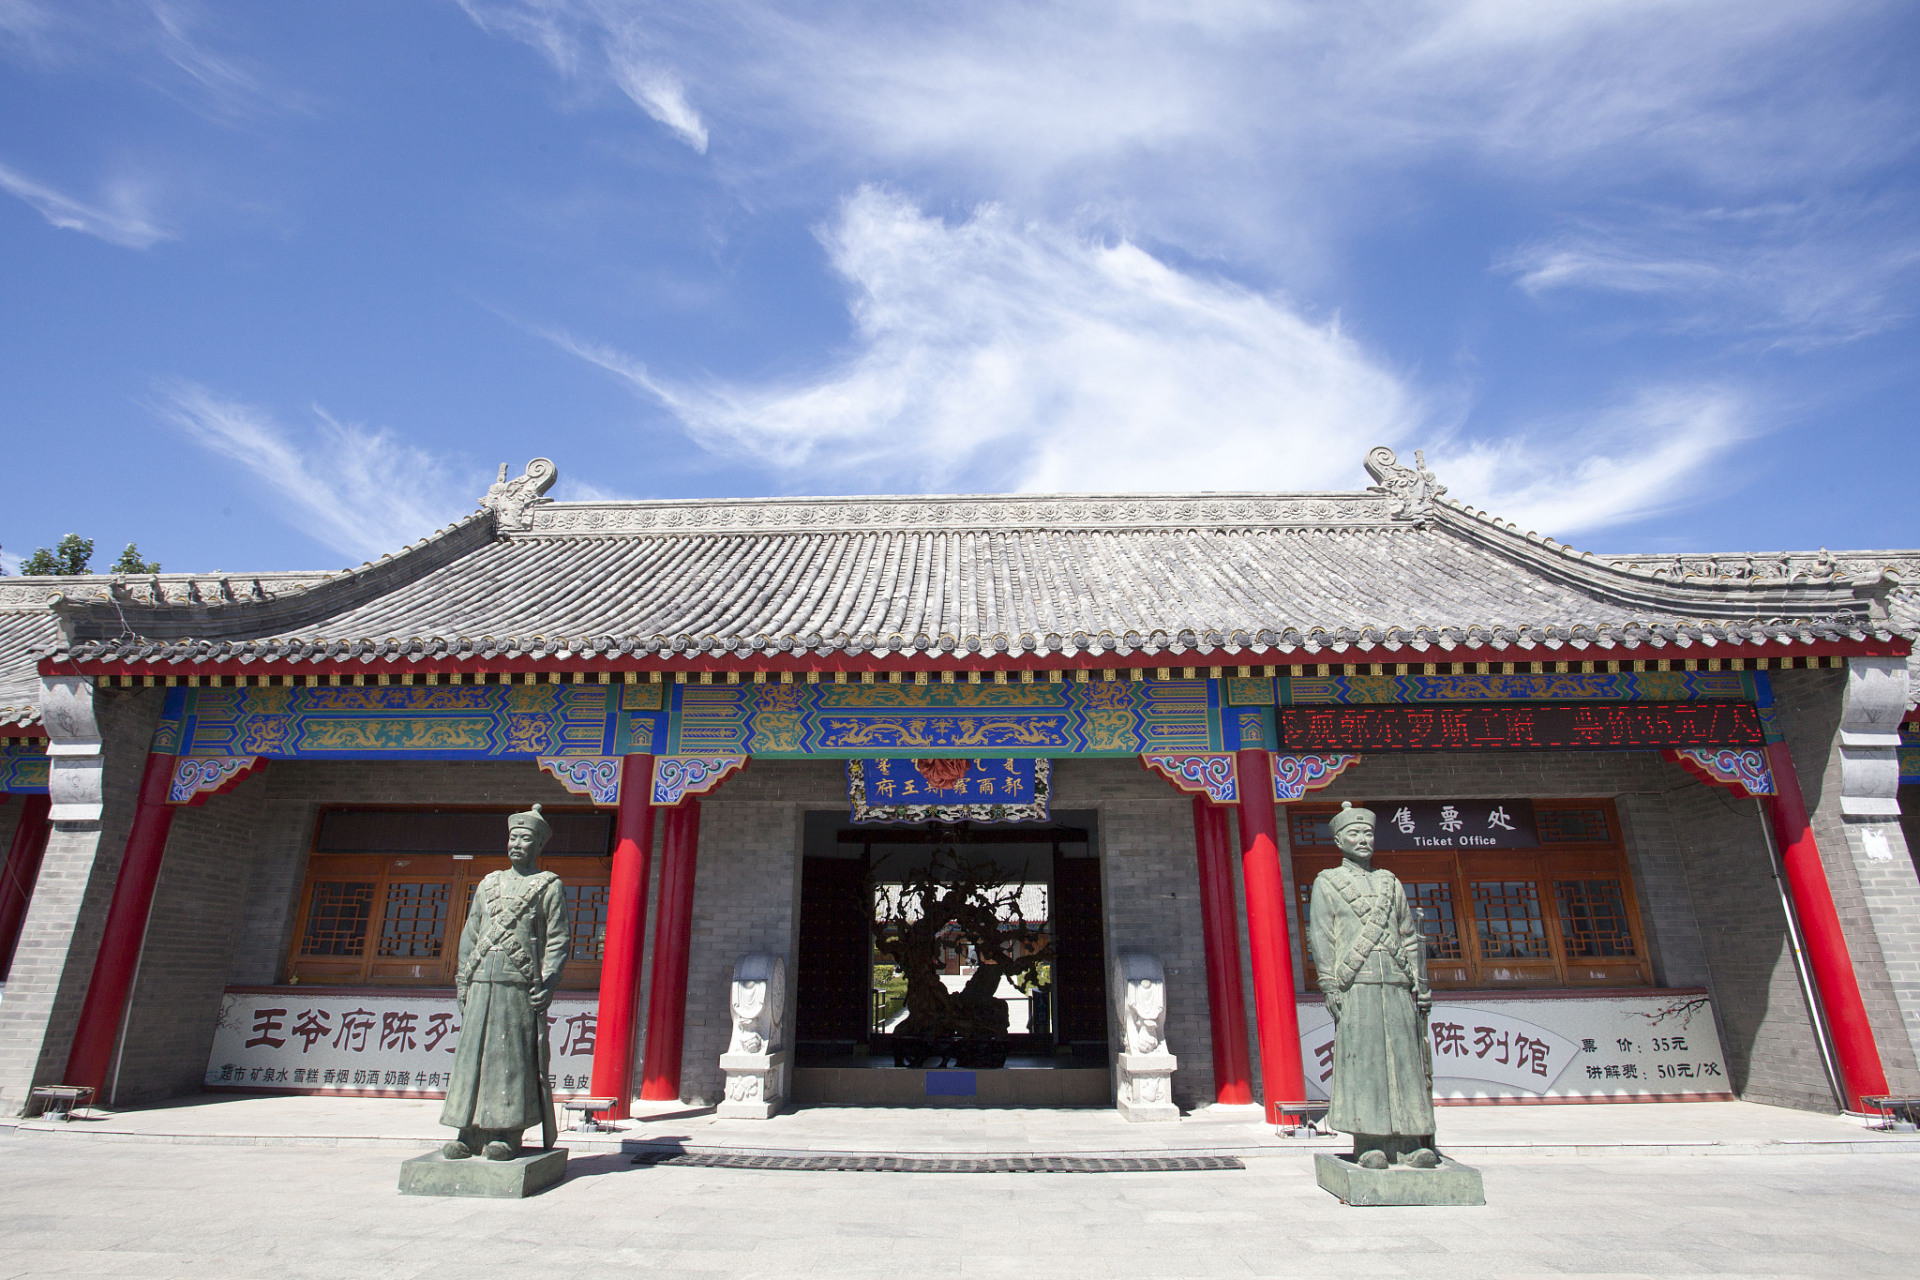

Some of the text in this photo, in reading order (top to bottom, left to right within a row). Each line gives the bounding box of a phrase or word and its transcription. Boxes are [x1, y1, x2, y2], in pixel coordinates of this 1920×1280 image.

[1390, 805, 1517, 834] 售票处
[1413, 835, 1497, 847] Ticket Office
[219, 1065, 245, 1081] 超市
[250, 1067, 289, 1082] 矿泉水
[293, 1068, 319, 1084] 雪糕
[323, 1069, 350, 1085] 香烟
[353, 1069, 380, 1085] 奶酒
[383, 1070, 410, 1086] 奶酪
[414, 1070, 451, 1087] 牛肉干
